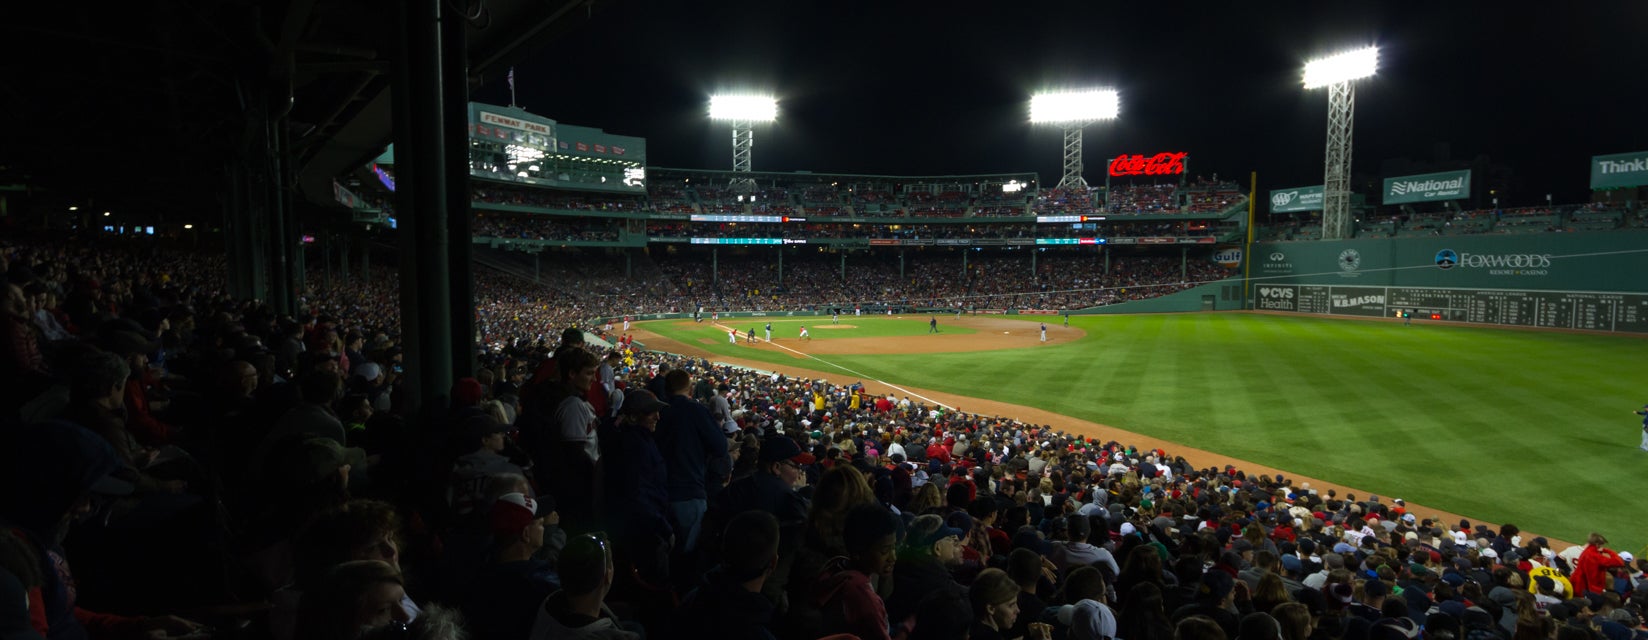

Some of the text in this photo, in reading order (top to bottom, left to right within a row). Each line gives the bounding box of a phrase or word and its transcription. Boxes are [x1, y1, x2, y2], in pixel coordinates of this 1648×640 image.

[485, 114, 547, 132] FENWAY PARK
[1407, 176, 1463, 193] National
[1215, 252, 1241, 261] Gulf
[1270, 287, 1294, 299] CVS
[1260, 298, 1293, 310] Health
